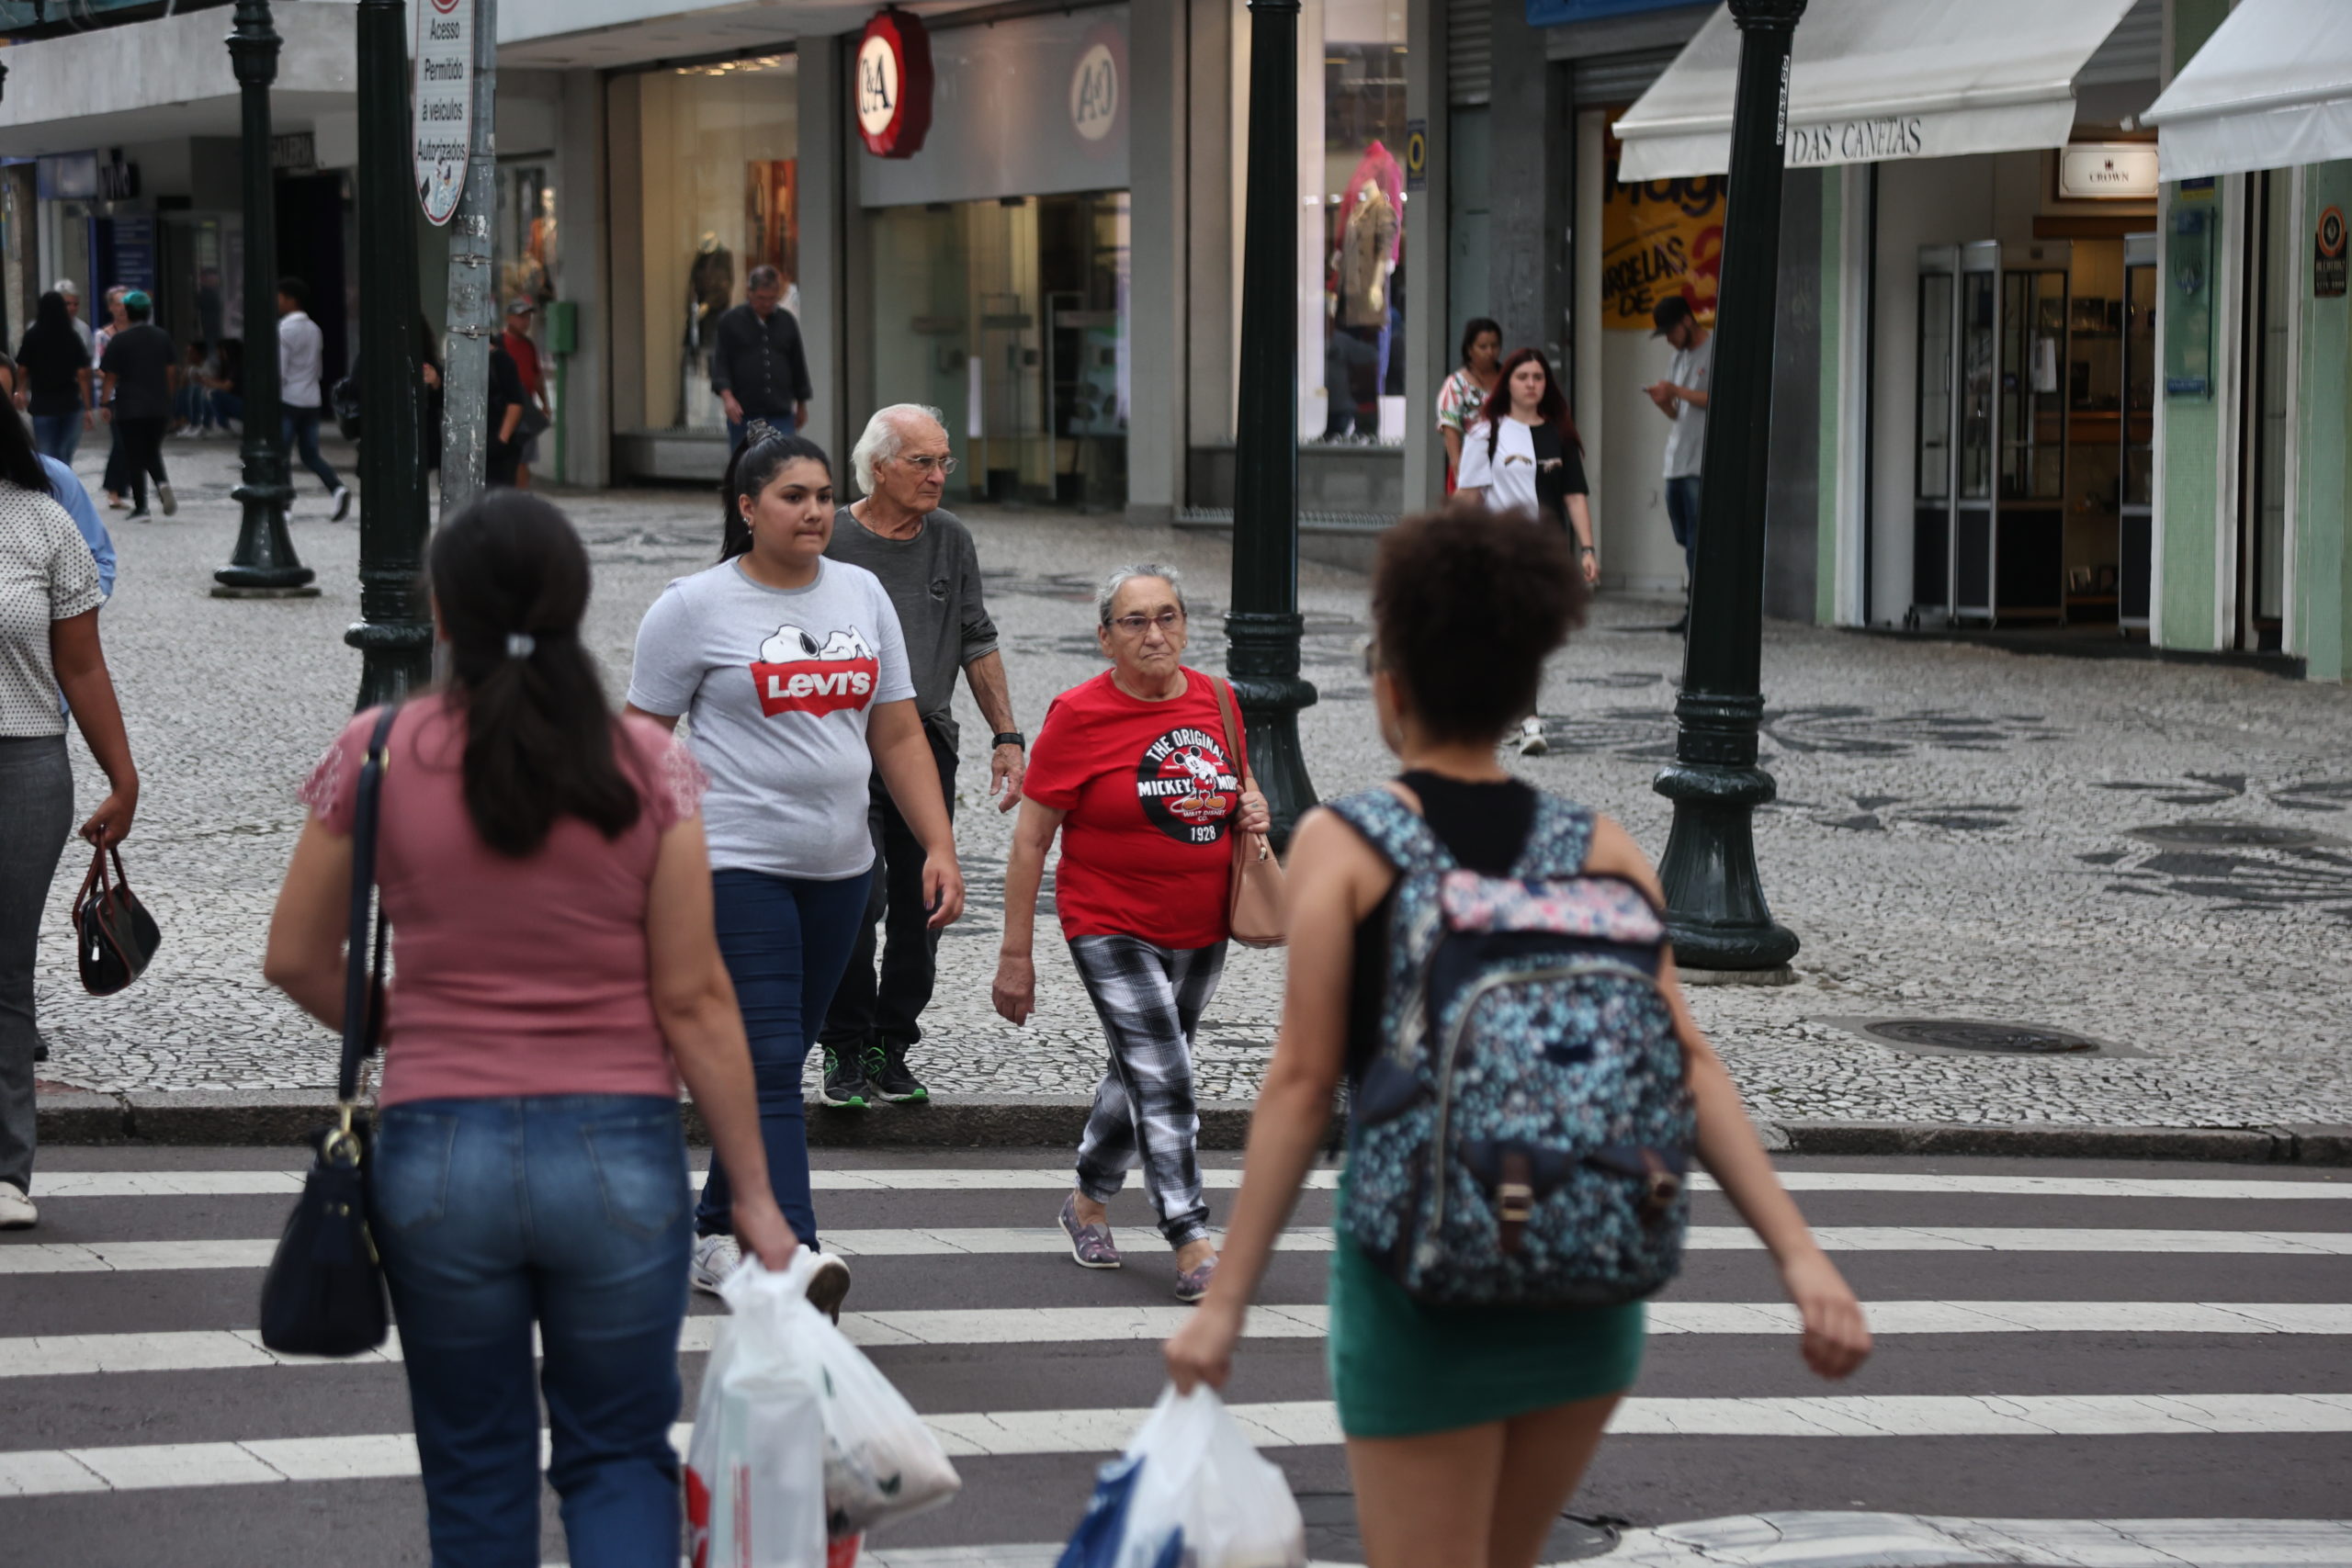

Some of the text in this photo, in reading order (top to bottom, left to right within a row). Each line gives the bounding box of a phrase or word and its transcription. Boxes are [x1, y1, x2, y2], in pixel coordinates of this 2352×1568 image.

[430, 18, 460, 40] Acesso
[424, 59, 463, 81] Permitido
[861, 53, 893, 115] C&A
[429, 97, 463, 121] veículos
[418, 138, 466, 162] Autorizados
[1792, 117, 1922, 164] DAS CANETAS
[2089, 171, 2130, 183] CROWN
[1619, 287, 1653, 317] DE
[1146, 728, 1226, 762] THE ORIGINAL
[1137, 778, 1192, 797] MICKEY
[1182, 808, 1227, 818] WALT DISNEY
[1191, 825, 1216, 841] 1928
